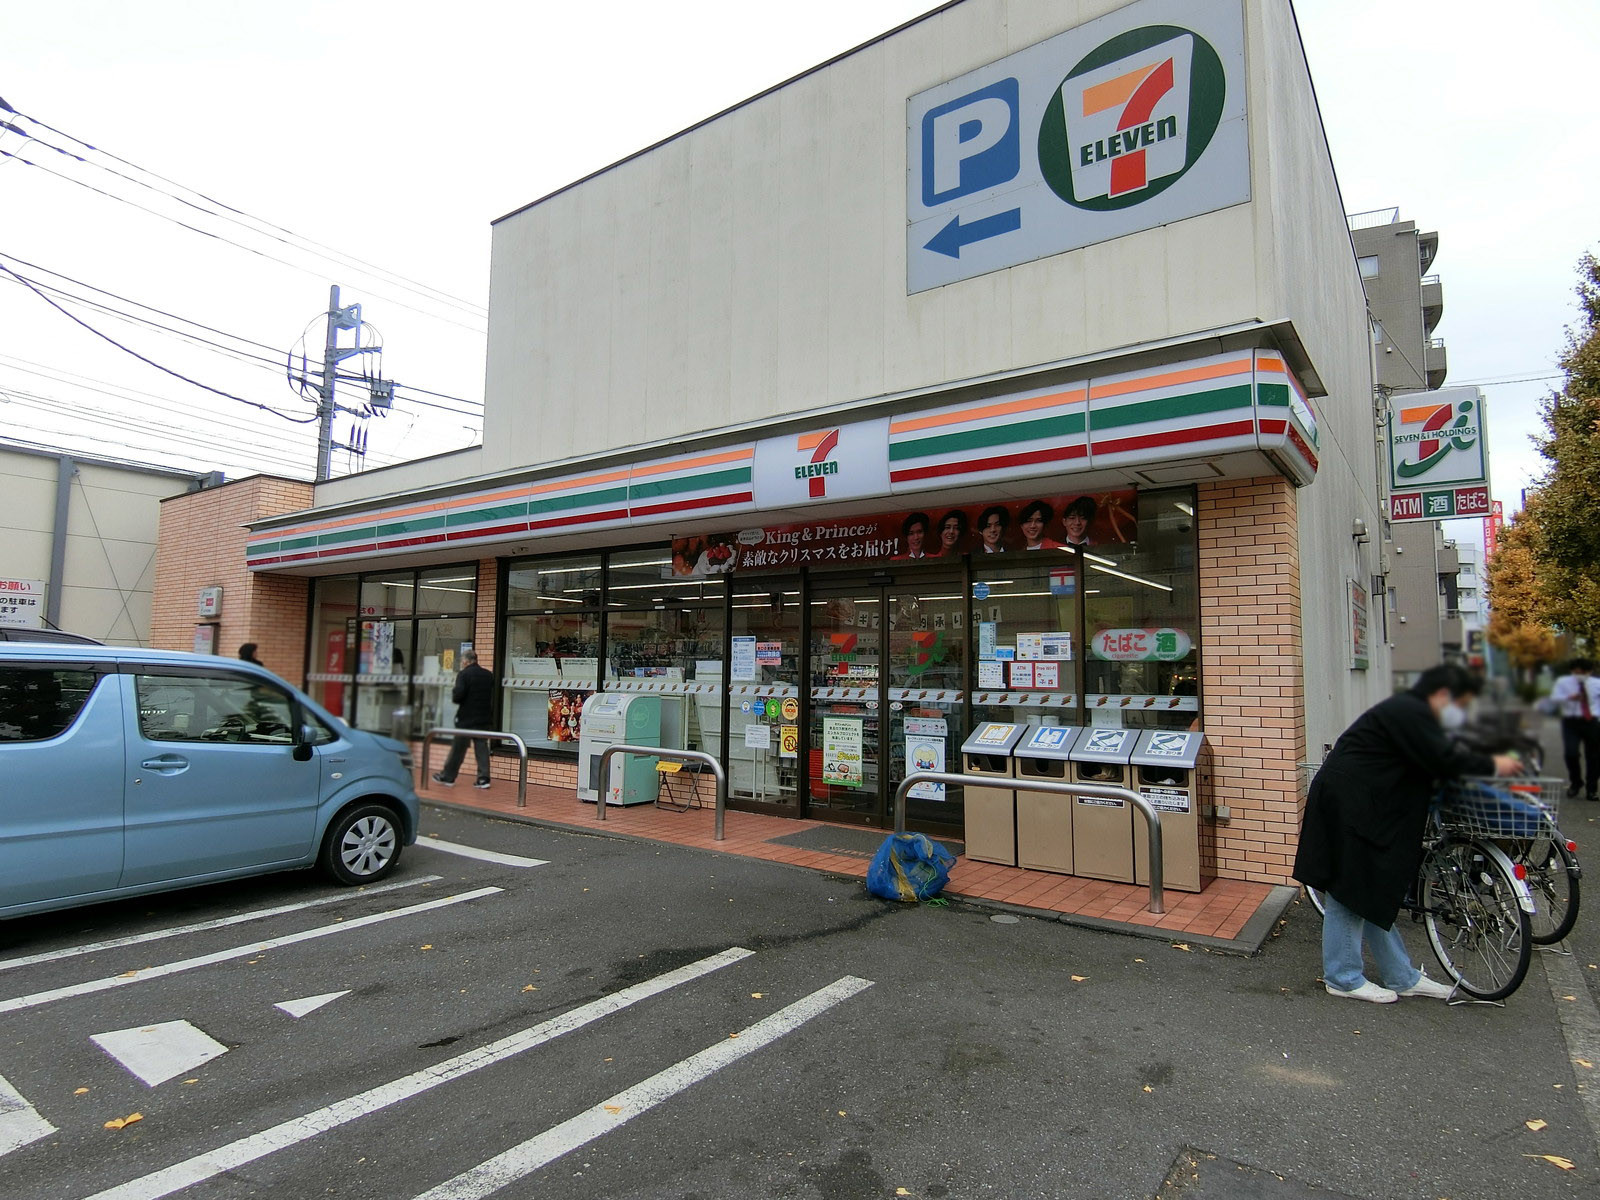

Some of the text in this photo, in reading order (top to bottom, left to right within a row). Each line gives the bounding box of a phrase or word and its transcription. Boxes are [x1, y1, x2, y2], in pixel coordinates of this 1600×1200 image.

[933, 97, 1011, 196] P
[1431, 426, 1477, 439] HOLDINGS
[1392, 497, 1421, 516] ATM
[1428, 495, 1449, 513] 酒
[1456, 492, 1488, 511] たばこ
[765, 530, 801, 546] King
[802, 527, 812, 542] &
[1103, 632, 1147, 653] たばこ
[1155, 632, 1176, 653] 酒
